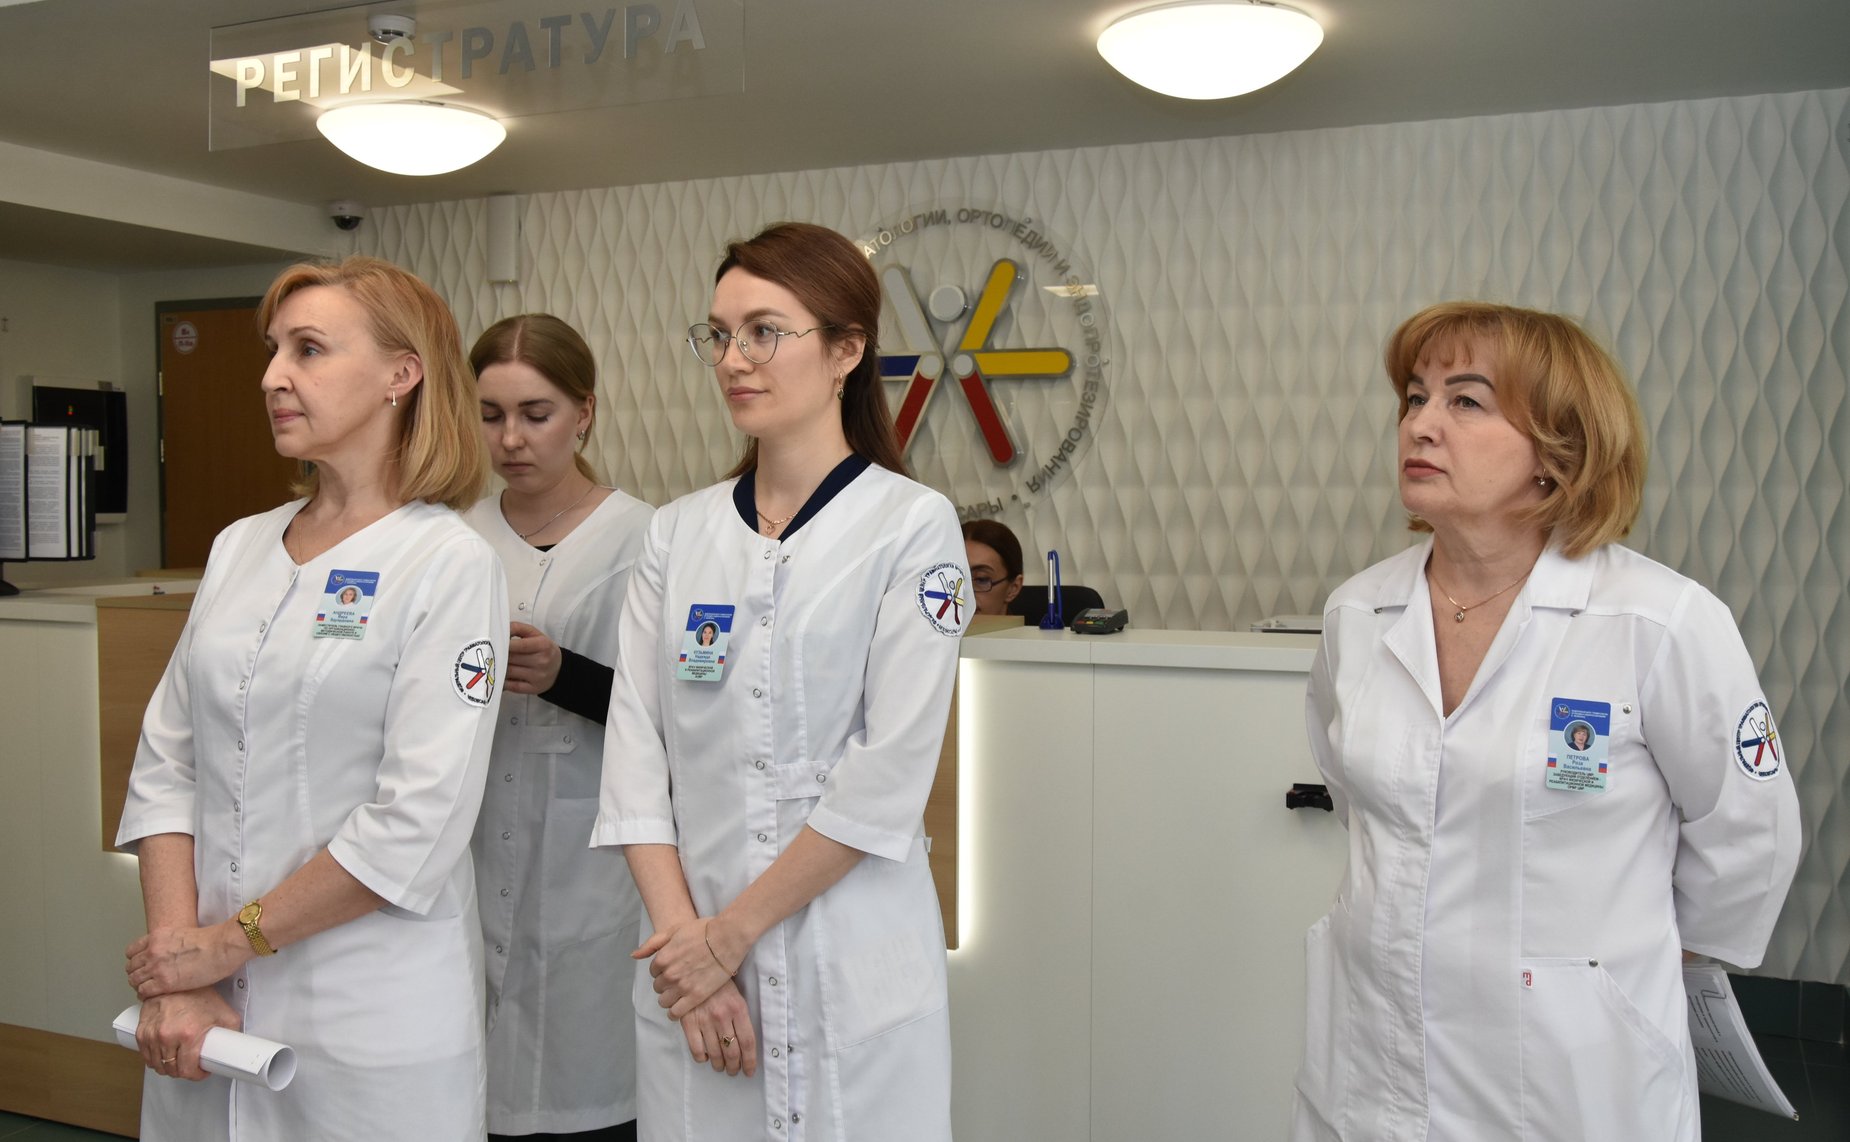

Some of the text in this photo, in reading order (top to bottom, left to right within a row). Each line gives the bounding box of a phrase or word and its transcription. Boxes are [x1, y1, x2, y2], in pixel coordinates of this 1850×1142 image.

[236, 0, 707, 107] РЕГИСТРАТУРА
[863, 209, 952, 260] АТОЛОГИИ,
[957, 208, 1058, 264] ОРТОПЕДИИ
[1055, 259, 1071, 276] И
[956, 497, 1004, 519] САРЫ
[1566, 754, 1590, 762] ПЕТРОВА
